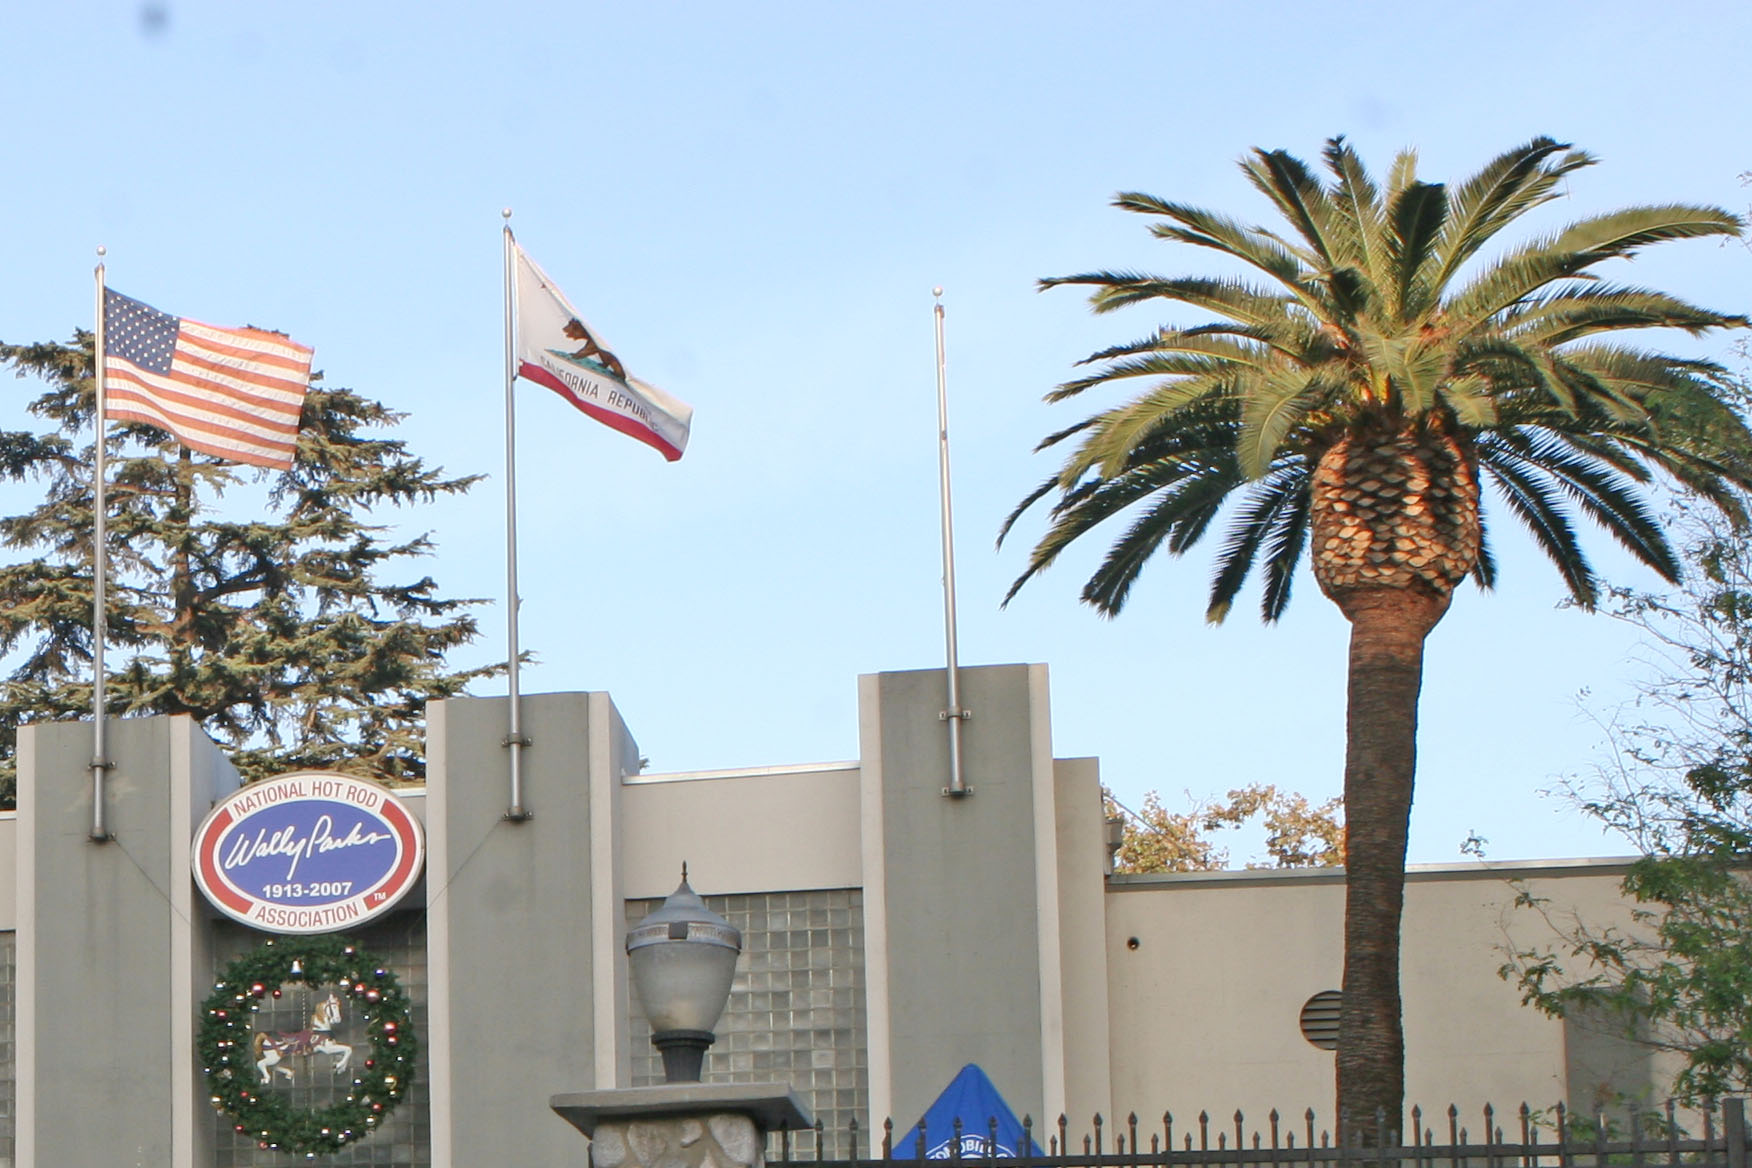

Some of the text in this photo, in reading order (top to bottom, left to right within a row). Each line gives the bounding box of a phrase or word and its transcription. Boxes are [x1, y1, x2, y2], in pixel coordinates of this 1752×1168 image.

[539, 355, 659, 432] CALIFORNIA REPUBLIC
[233, 780, 378, 817] NATIONAL HOT ROD
[224, 814, 391, 880] Wally Parks
[262, 881, 353, 899] 1913-2007
[254, 901, 359, 928] ASSOCIATION
